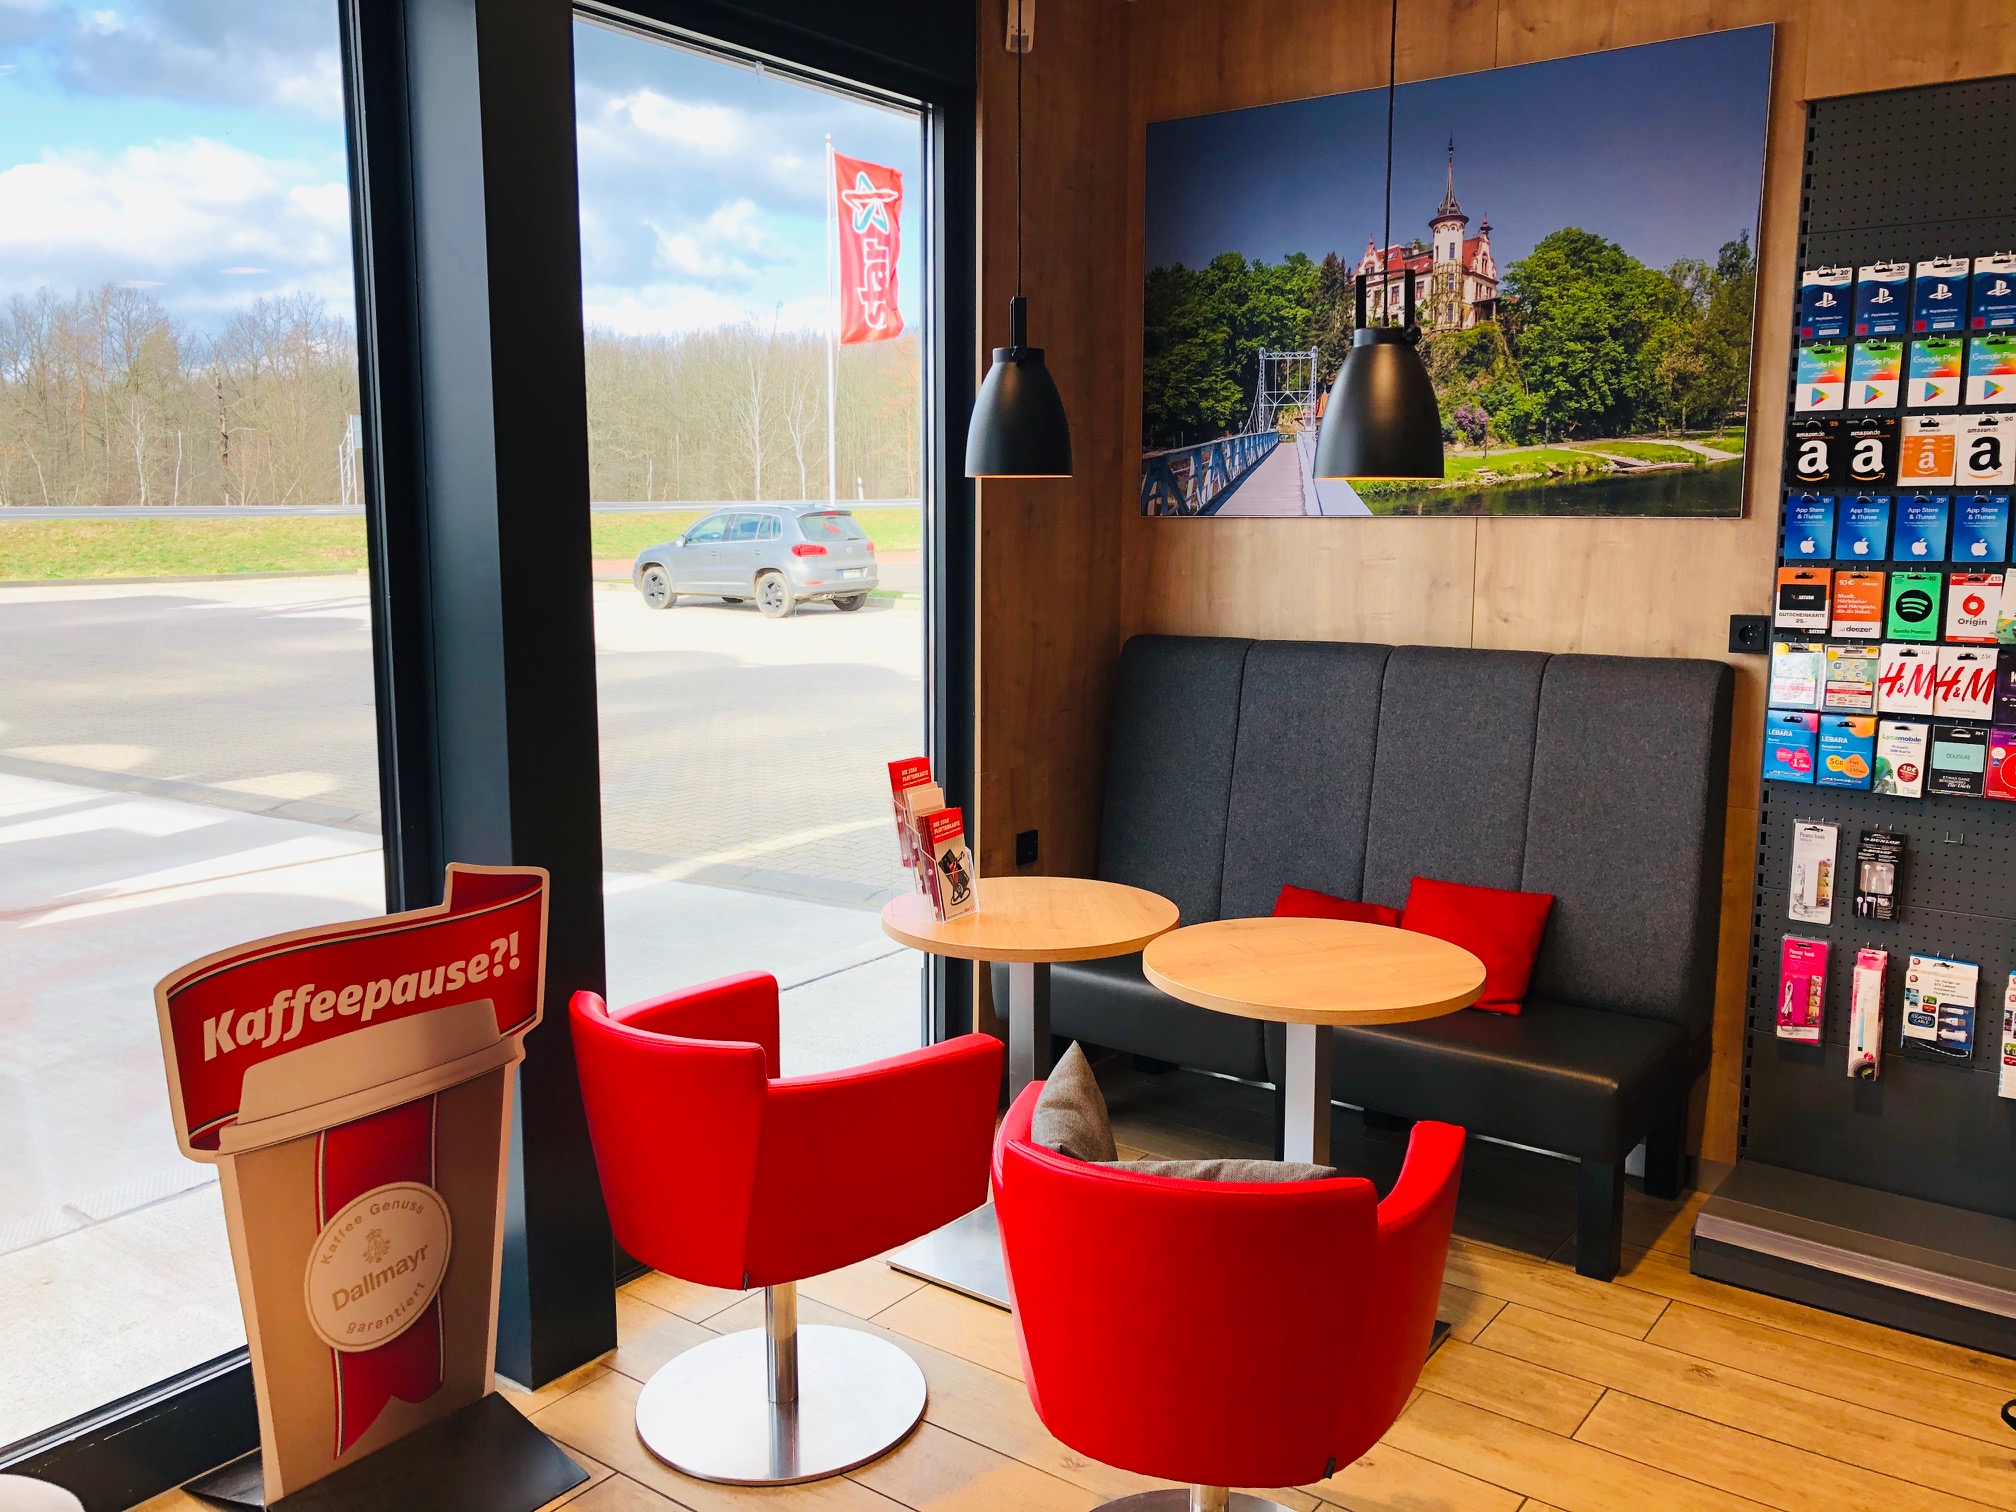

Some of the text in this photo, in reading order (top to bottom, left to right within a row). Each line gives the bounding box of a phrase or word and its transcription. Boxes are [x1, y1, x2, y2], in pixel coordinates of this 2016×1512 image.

[857, 238, 889, 329] star
[1801, 361, 1827, 369] Google
[1856, 358, 1882, 366] Google
[1913, 355, 1942, 364] Google
[1973, 352, 2001, 360] Google
[1958, 618, 1987, 626] Origin
[1879, 662, 1936, 700] H&M
[1934, 666, 1996, 705] H&M
[1882, 734, 1921, 742] Lycamobile
[203, 931, 520, 1061] Kaffeepause?!
[320, 1200, 424, 1264] Kaffee Genuss
[332, 1244, 428, 1311] Dallmayr
[346, 1282, 425, 1334] garantiert
